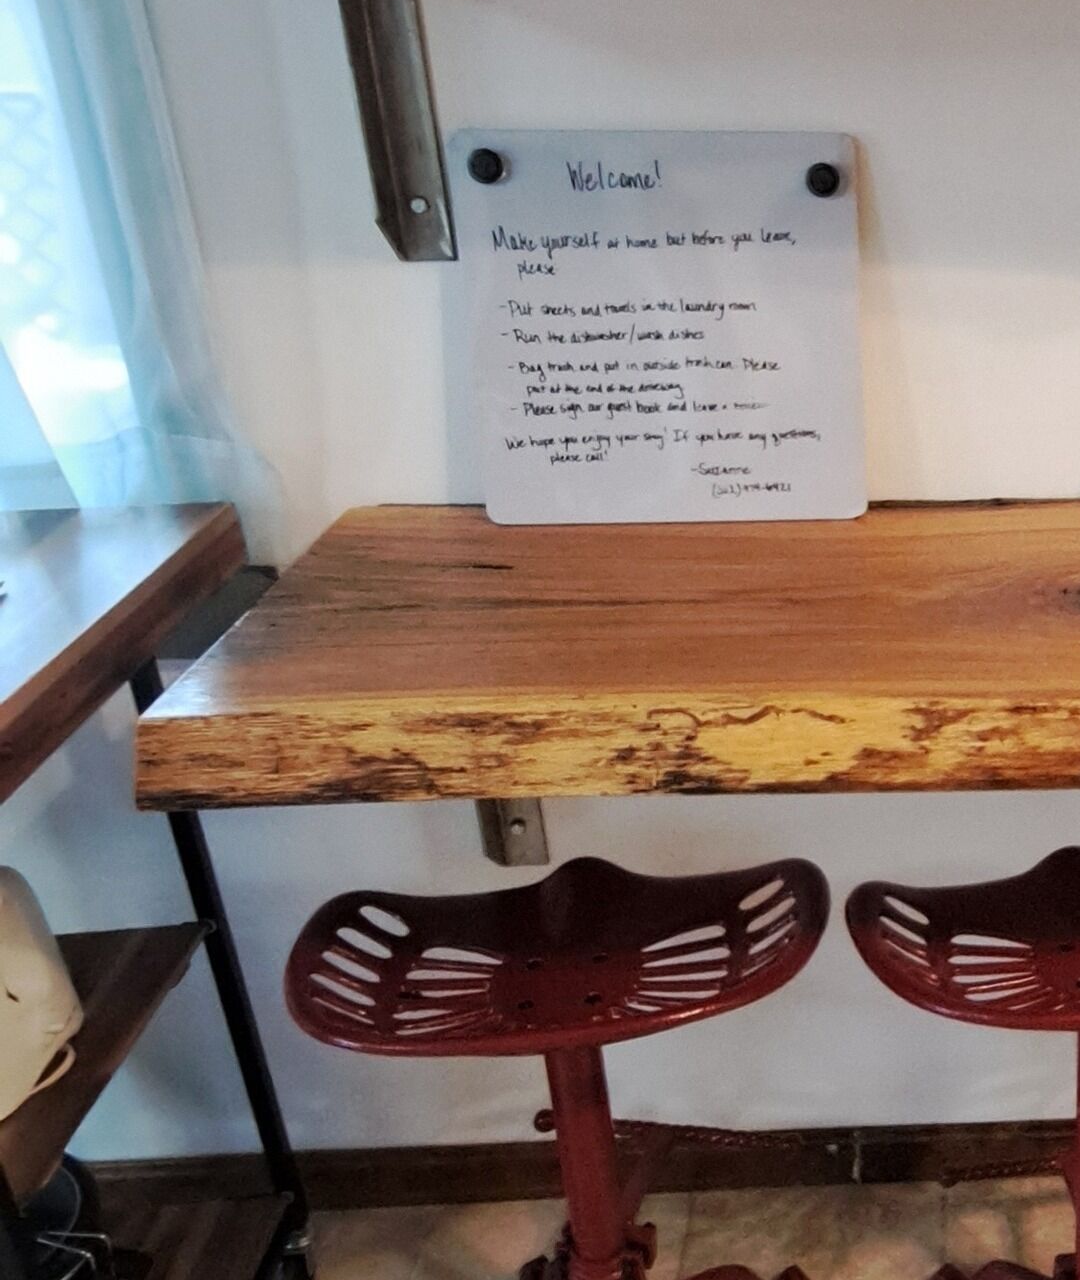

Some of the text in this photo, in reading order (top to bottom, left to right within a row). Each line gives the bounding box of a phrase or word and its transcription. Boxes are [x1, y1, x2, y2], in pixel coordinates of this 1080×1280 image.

[566, 159, 663, 192] Welcome!
[492, 225, 537, 251] Make
[541, 231, 599, 259] yourself
[625, 234, 658, 249] home
[666, 231, 686, 246] but
[691, 229, 725, 245] before
[731, 232, 753, 252] you
[760, 227, 797, 245] leave,
[517, 260, 556, 280] please
[540, 304, 576, 317] sheets
[581, 305, 602, 317] and
[604, 301, 637, 315] towels
[641, 299, 656, 311] in
[657, 301, 677, 312] the
[679, 298, 725, 320] laundry
[728, 302, 757, 311] room
[548, 330, 566, 344] the
[548, 361, 574, 372] trash
[579, 362, 599, 373] and
[604, 360, 619, 374] put
[626, 361, 638, 371] in
[643, 358, 680, 371] outside
[742, 357, 781, 371] Please
[586, 383, 603, 394] end
[560, 399, 583, 420] sign
[636, 400, 661, 414] book
[667, 401, 687, 412] and
[505, 436, 526, 451] We
[529, 434, 556, 450] hope
[559, 435, 578, 451] you
[582, 434, 611, 451] enjoy
[615, 434, 639, 447] your
[673, 429, 688, 441] If
[695, 433, 714, 447] you
[717, 428, 743, 441] have
[749, 432, 766, 449] any
[550, 452, 582, 466] please
